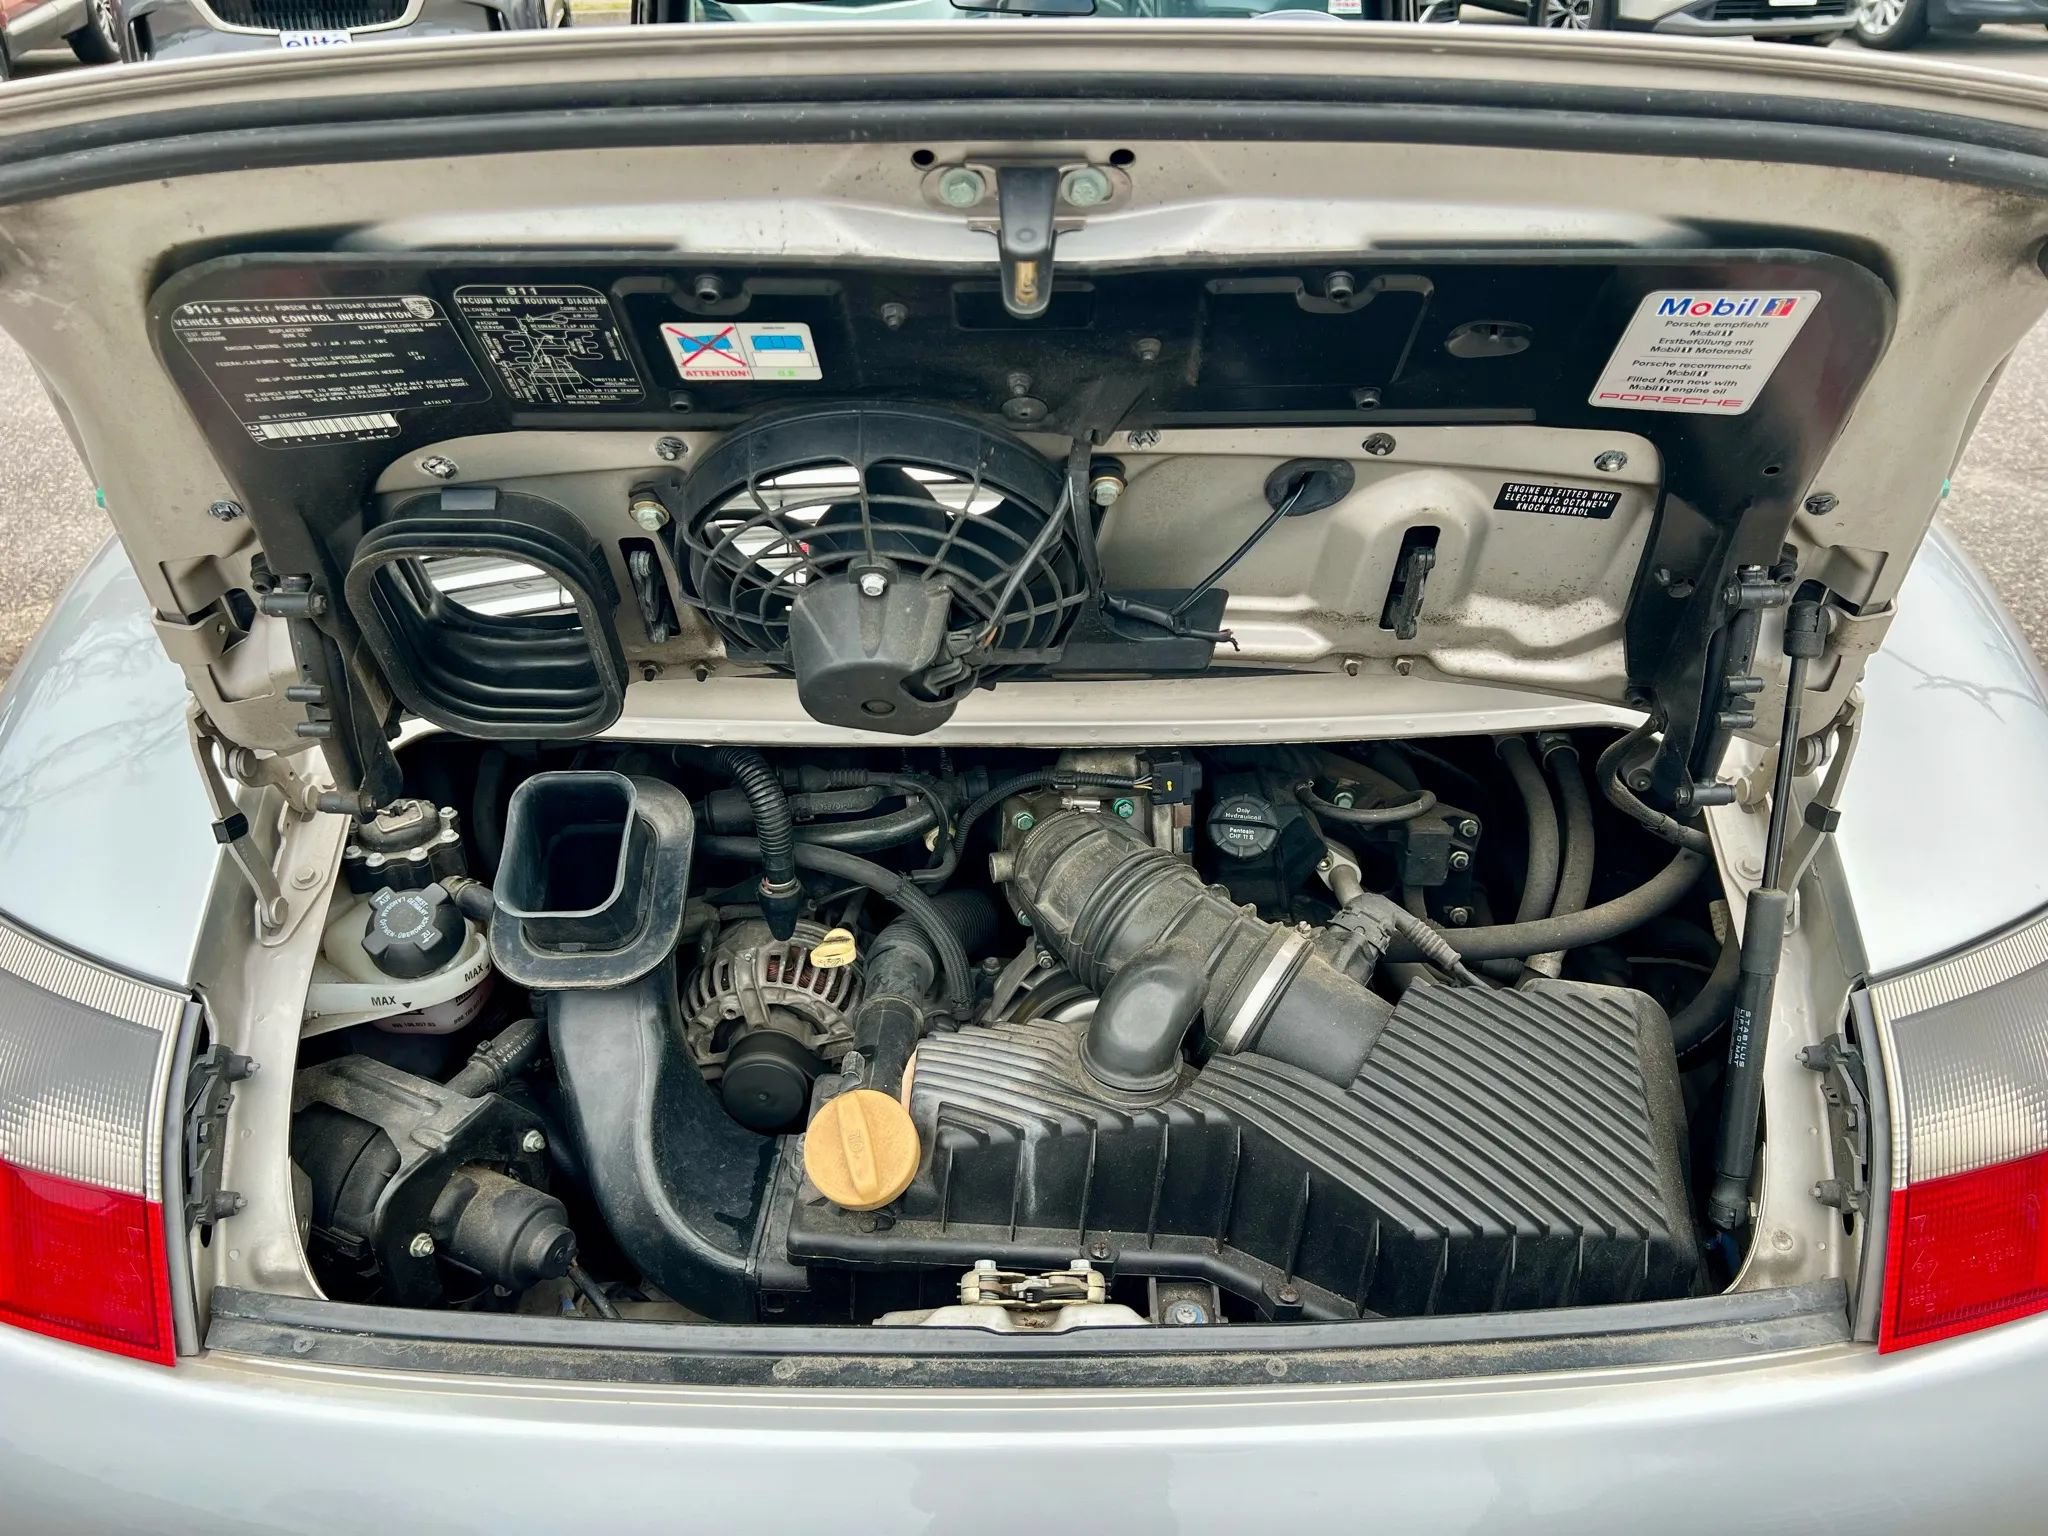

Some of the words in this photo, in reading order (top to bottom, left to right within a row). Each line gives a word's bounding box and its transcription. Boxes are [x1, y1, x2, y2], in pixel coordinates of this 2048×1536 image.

[507, 287, 537, 295] 911
[456, 297, 493, 305] VACUUM
[496, 297, 521, 305] HOSE
[524, 297, 564, 305] ROUTING
[568, 297, 608, 305] DIAGRAM
[183, 305, 211, 315] 911
[1657, 298, 1760, 316] Mobil
[174, 318, 221, 326] VEHICLE
[224, 316, 278, 325] EMISSION
[281, 314, 334, 323] CONTROL
[337, 311, 412, 320] INFORMATION
[1665, 320, 1711, 328] Porsche
[1714, 321, 1769, 329] empfiehlt
[1658, 338, 1733, 347] Erstbefüllung
[1694, 347, 1752, 355] Motorenöl
[1632, 360, 1676, 368] Porsche
[1626, 376, 1656, 384] Filled
[1659, 377, 1684, 385] from
[1714, 379, 1737, 387] with
[1672, 386, 1710, 394] engine
[1600, 393, 1743, 407] PORSCHE
[247, 424, 267, 442] VEC
[1507, 484, 1541, 495] ENGINE
[1556, 489, 1590, 499] FITTED
[1592, 492, 1615, 501] WITH
[1505, 493, 1559, 505] ELECTRONIC
[1516, 502, 1545, 512] KNOCK
[1549, 504, 1588, 516] CONTROL
[464, 964, 484, 981] MAX
[370, 995, 397, 1006] MAX
[1739, 1010, 1752, 1068] STABILUS
